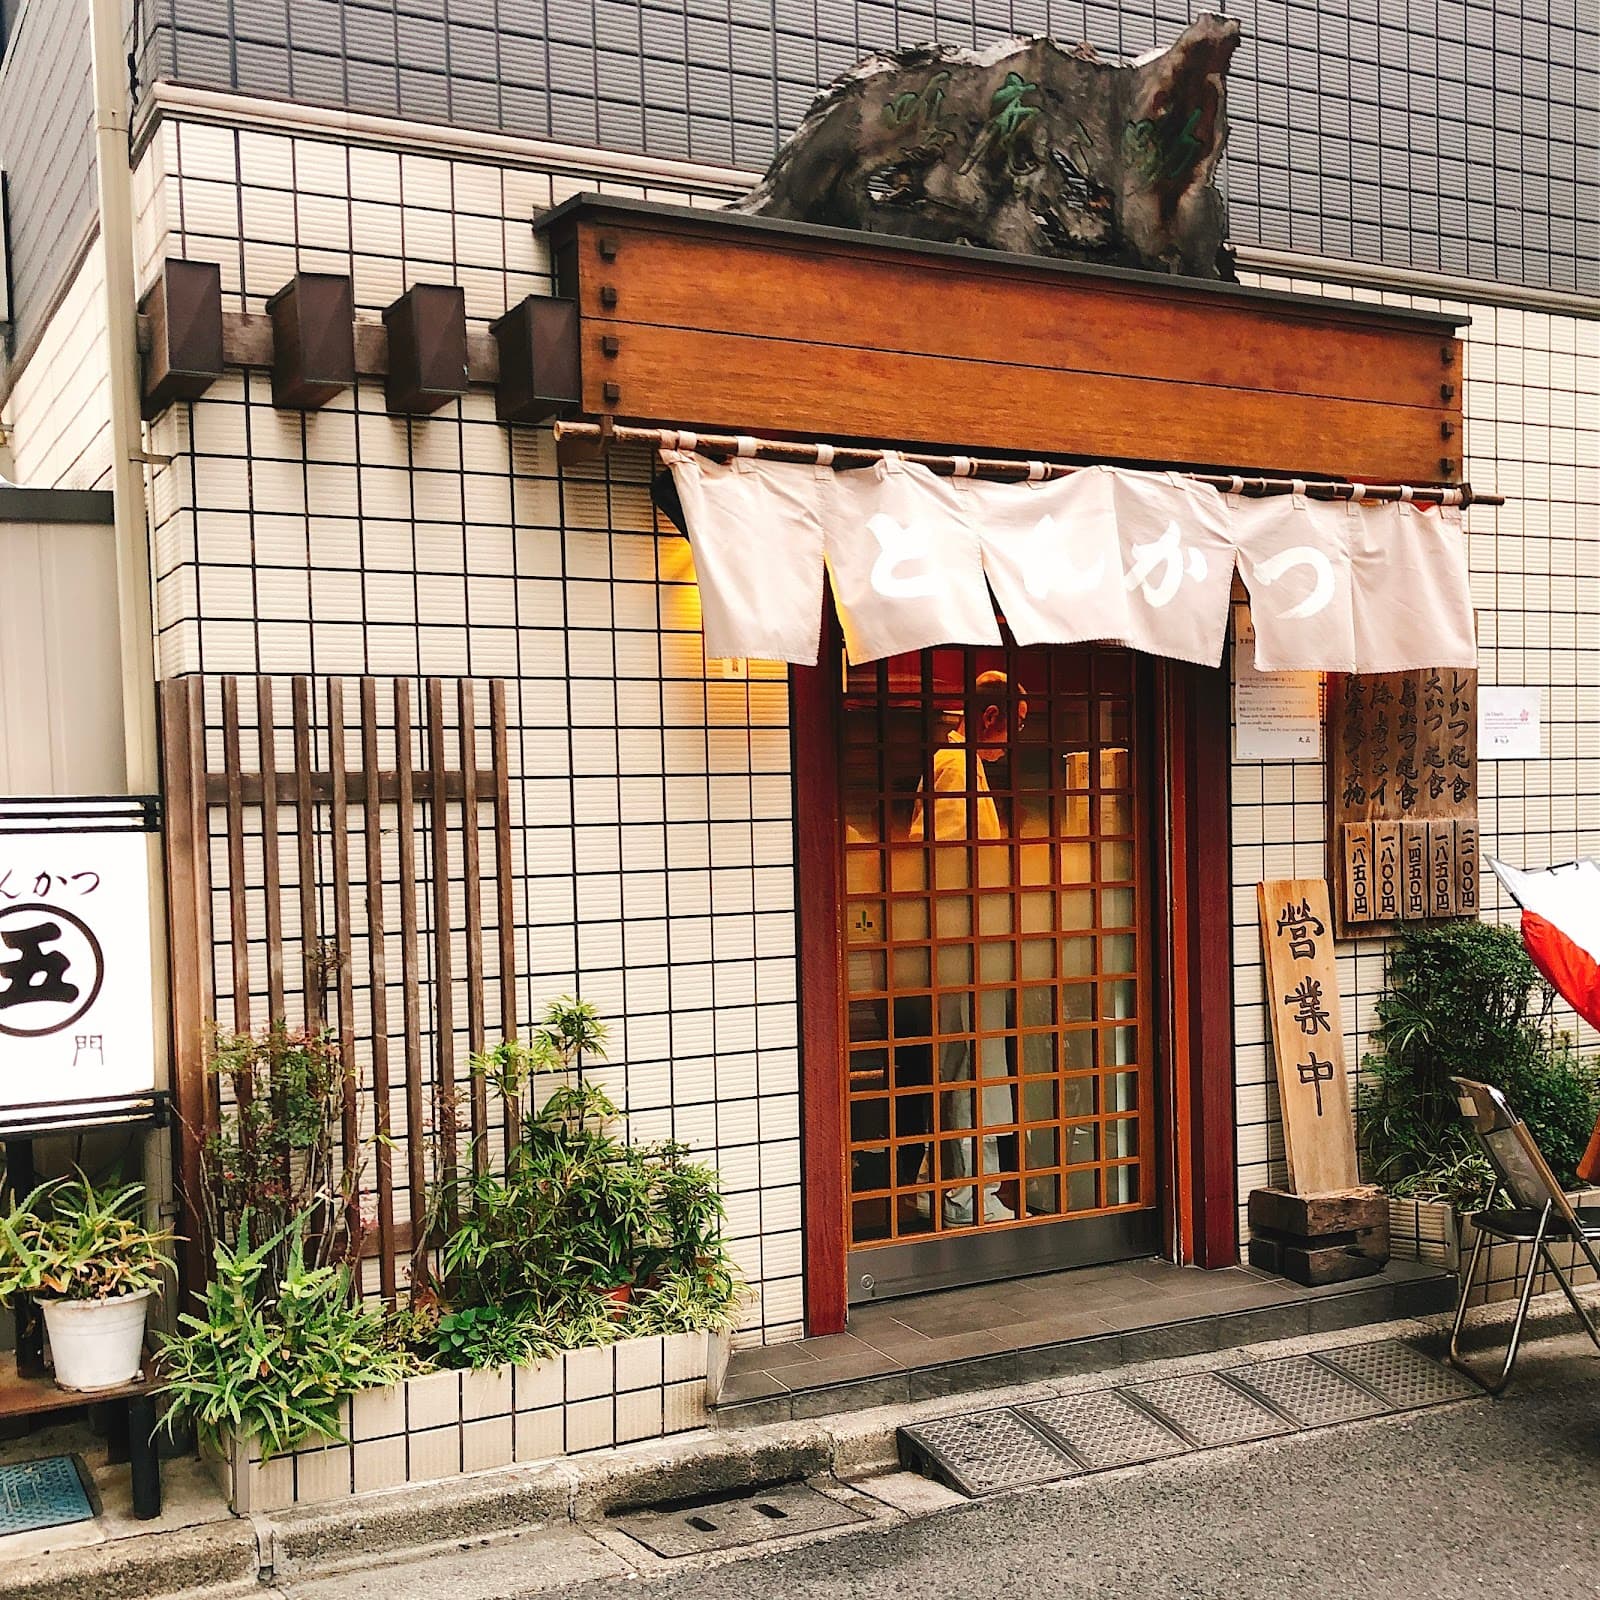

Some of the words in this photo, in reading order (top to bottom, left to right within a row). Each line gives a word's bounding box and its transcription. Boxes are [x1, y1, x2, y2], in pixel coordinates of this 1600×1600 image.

[865, 513, 1335, 618] とんかつ
[73, 1035, 104, 1066] 門
